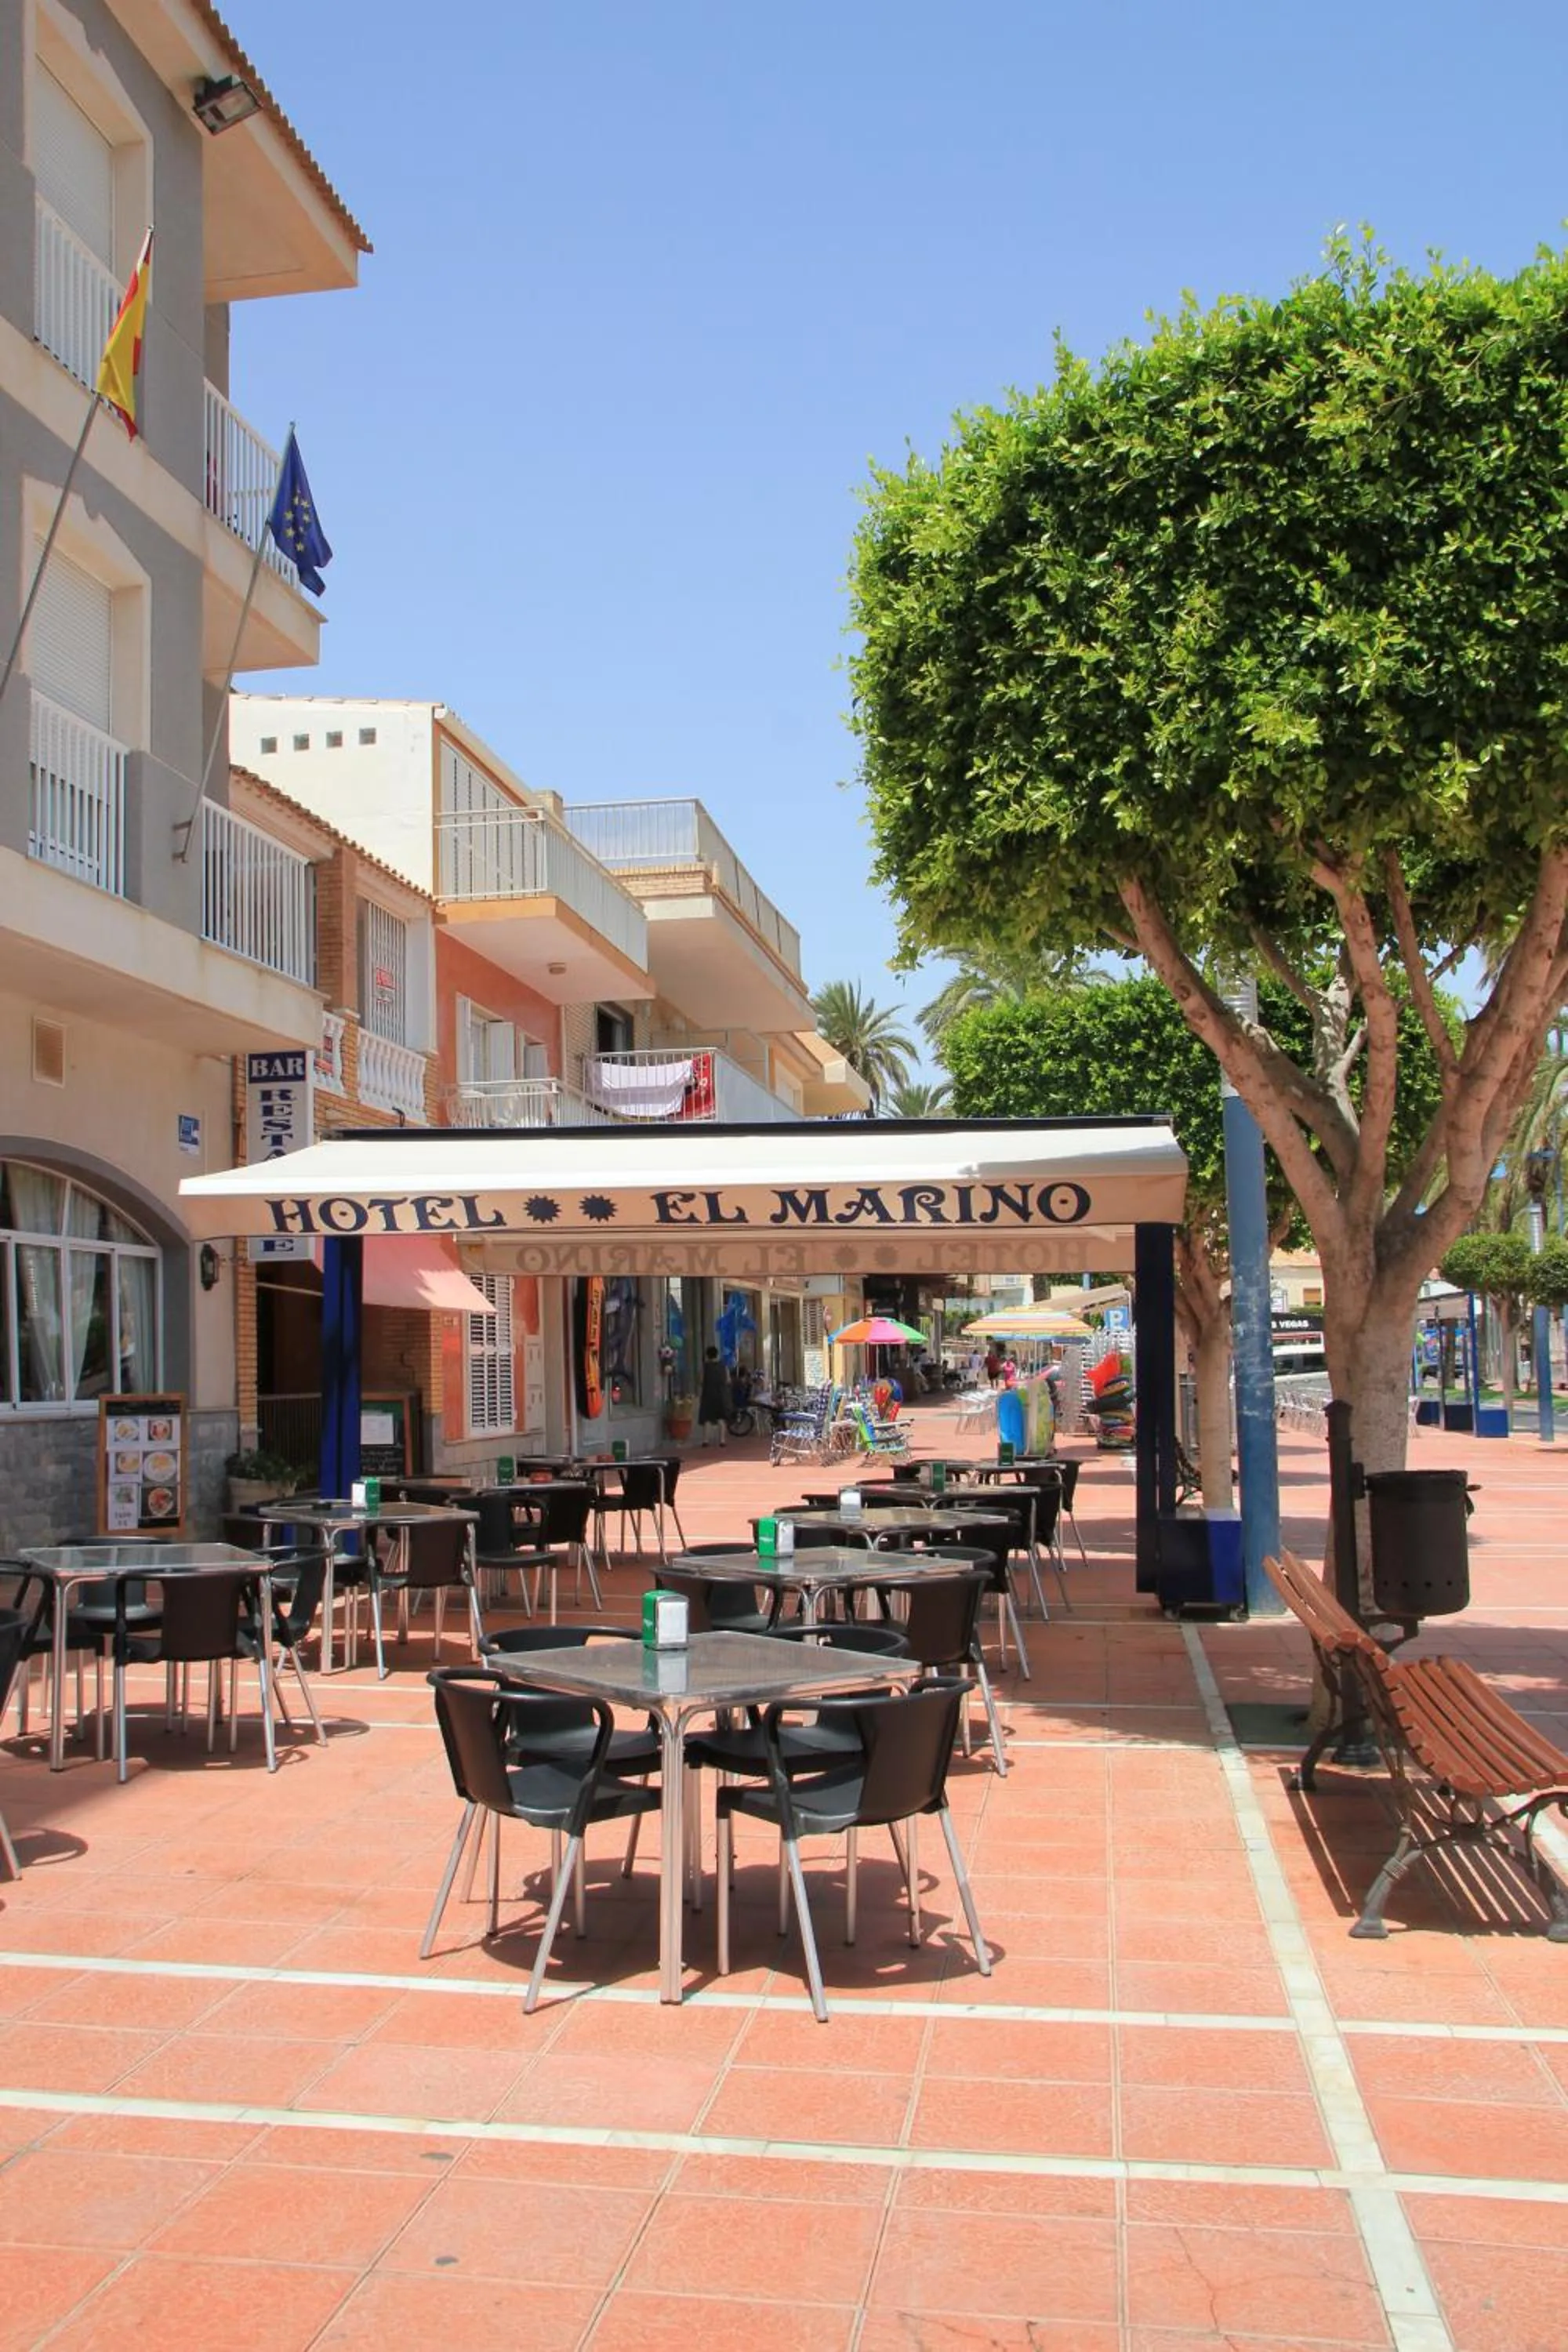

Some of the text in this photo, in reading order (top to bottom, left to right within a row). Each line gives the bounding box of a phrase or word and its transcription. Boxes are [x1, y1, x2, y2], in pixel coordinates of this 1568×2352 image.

[250, 1058, 304, 1078] BAR
[265, 1181, 1091, 1233] HOTEL EL MARINO
[1279, 1319, 1309, 1329] VEGAS
